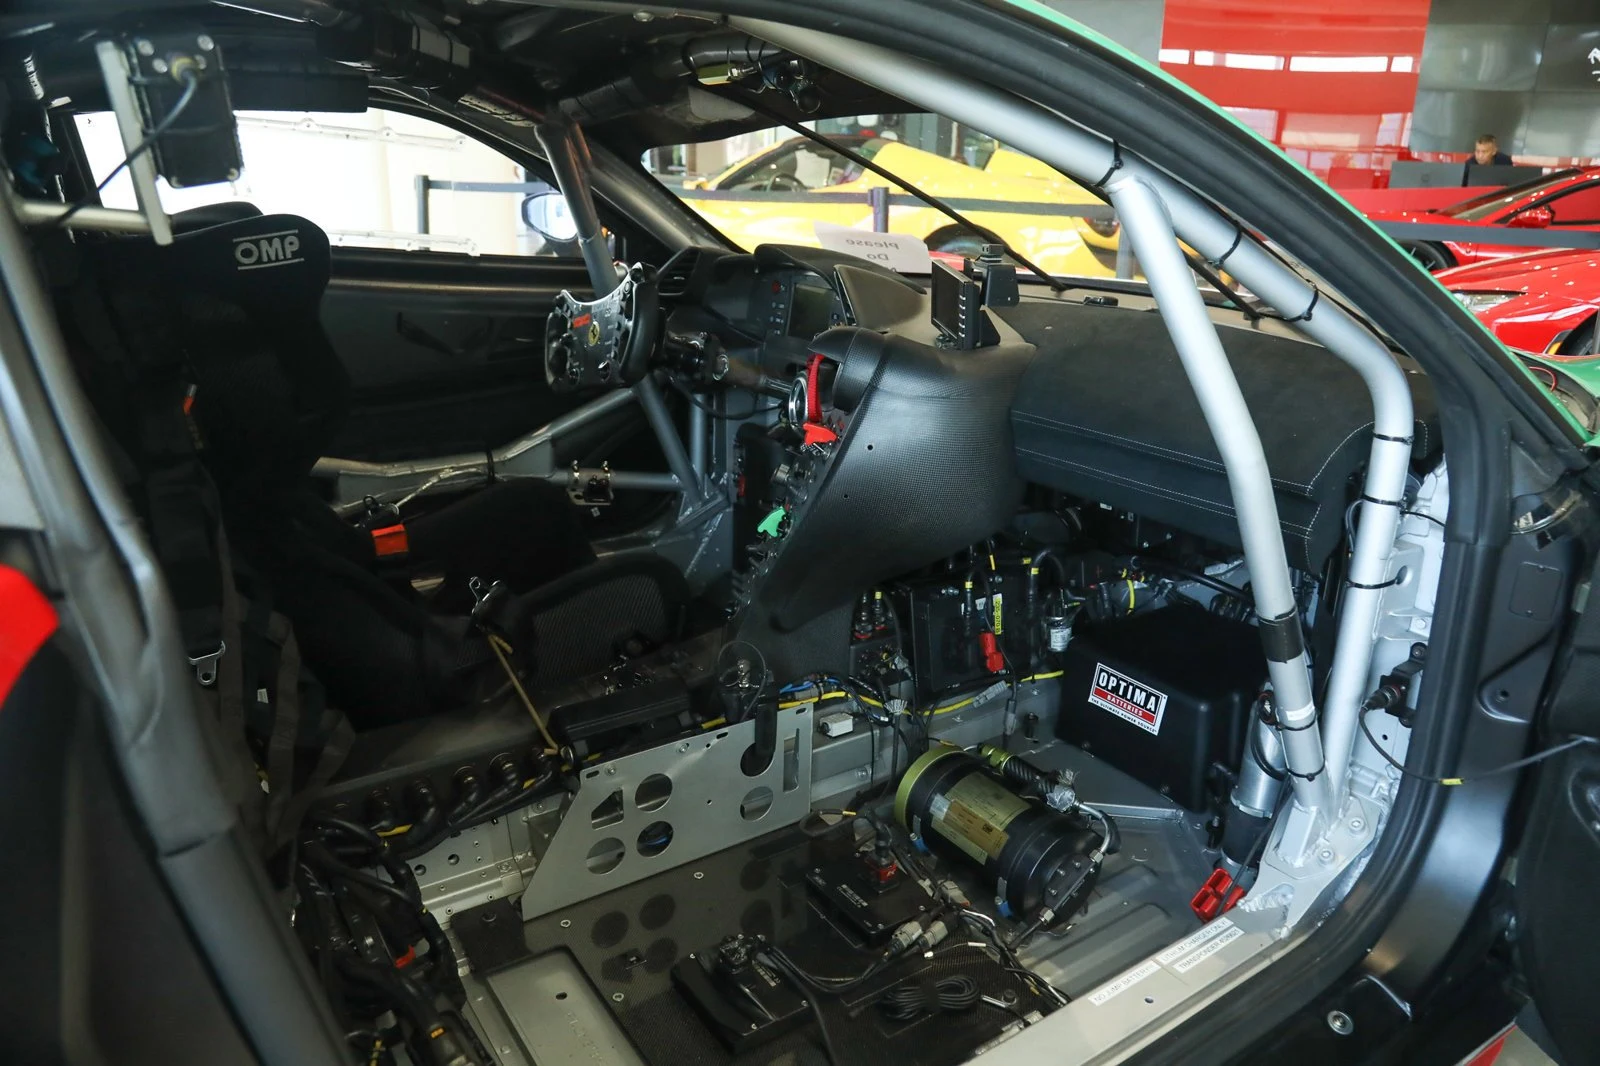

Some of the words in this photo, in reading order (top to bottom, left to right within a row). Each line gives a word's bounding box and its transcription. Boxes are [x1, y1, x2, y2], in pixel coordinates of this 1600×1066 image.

[235, 235, 300, 264] OMP
[1098, 671, 1156, 712] OPTIMA
[1106, 694, 1143, 717] BATTERIES
